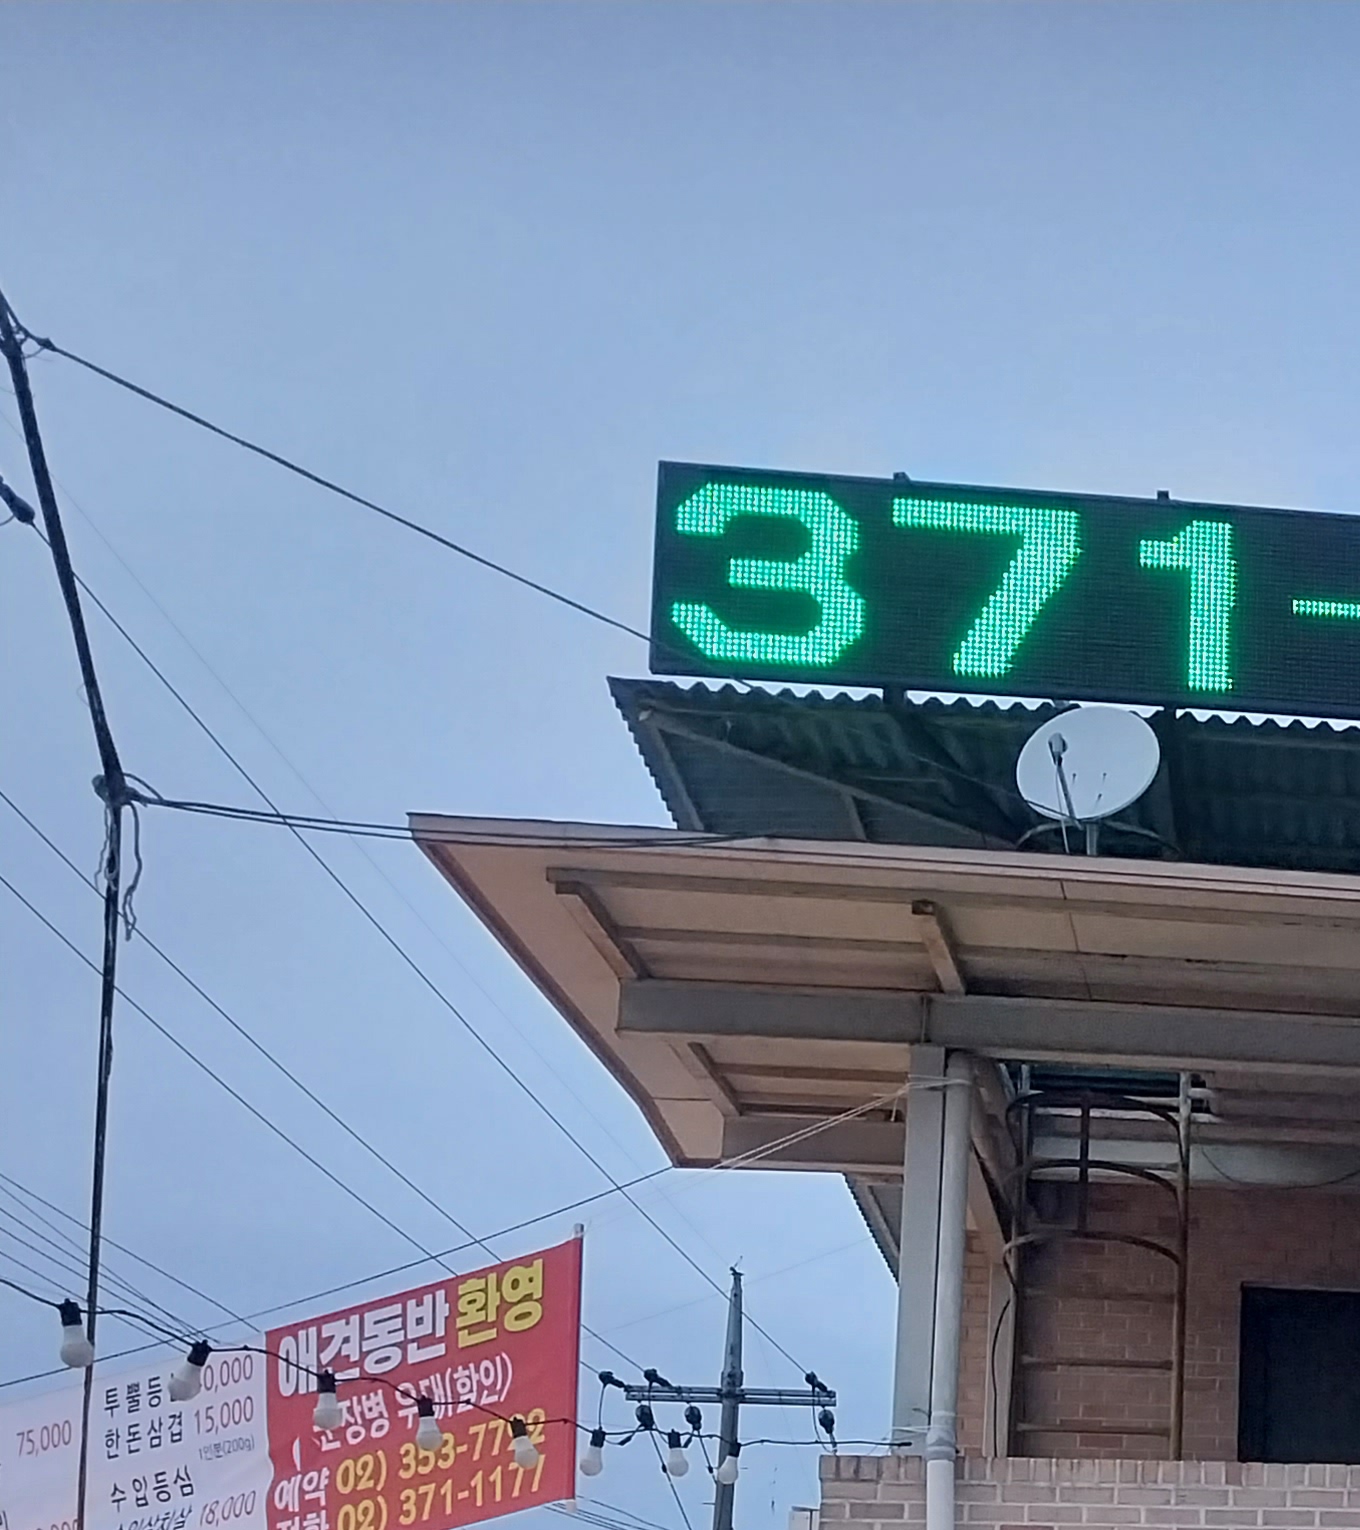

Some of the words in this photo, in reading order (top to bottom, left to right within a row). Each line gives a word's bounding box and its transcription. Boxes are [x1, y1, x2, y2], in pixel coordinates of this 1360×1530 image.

[279, 1289, 449, 1396] 애견동반
[456, 1259, 543, 1349] 환영
[104, 1372, 192, 1418] 투뿔등
[195, 1354, 253, 1397] 0,000
[16, 1419, 72, 1457] 75,000
[194, 1396, 254, 1435] 15,000
[110, 1465, 194, 1513] 수입등심
[274, 1466, 329, 1512] 예약
[335, 1450, 388, 1495] 02)
[399, 1455, 546, 1525] 371-1177
[199, 1490, 256, 1528] 18,000
